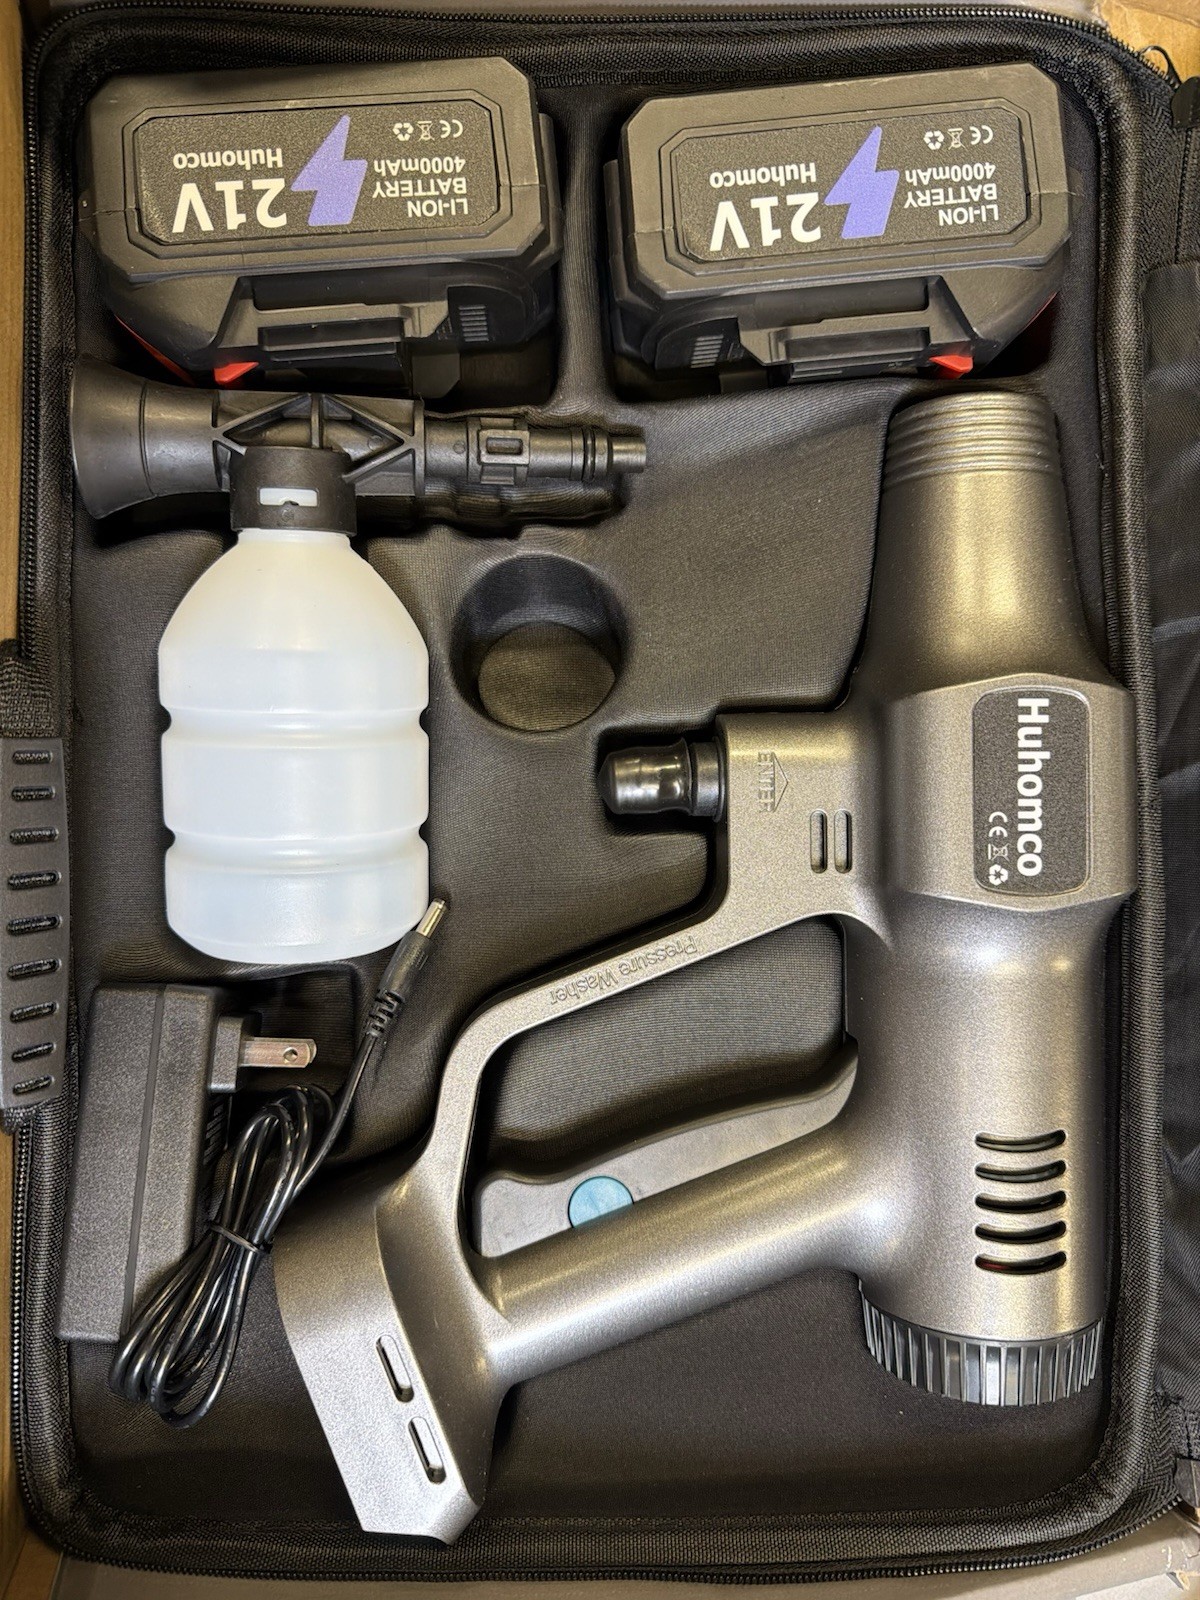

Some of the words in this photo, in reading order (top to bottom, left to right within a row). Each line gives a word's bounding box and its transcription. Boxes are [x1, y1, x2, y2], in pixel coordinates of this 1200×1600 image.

[173, 148, 283, 169] Huhomco
[373, 157, 466, 176] 4000mAh
[709, 162, 817, 188] Huhomco
[904, 162, 996, 185] 4000mAh
[372, 177, 467, 198] BATTERY
[903, 183, 998, 208] BATTERY
[172, 178, 287, 233] 21V
[407, 198, 469, 218] LI-ION
[938, 204, 999, 226] LI-ION
[709, 192, 821, 252] 21V
[1016, 698, 1051, 876] Huhomco
[618, 935, 698, 977] Pressure
[550, 968, 619, 1005] Washer
